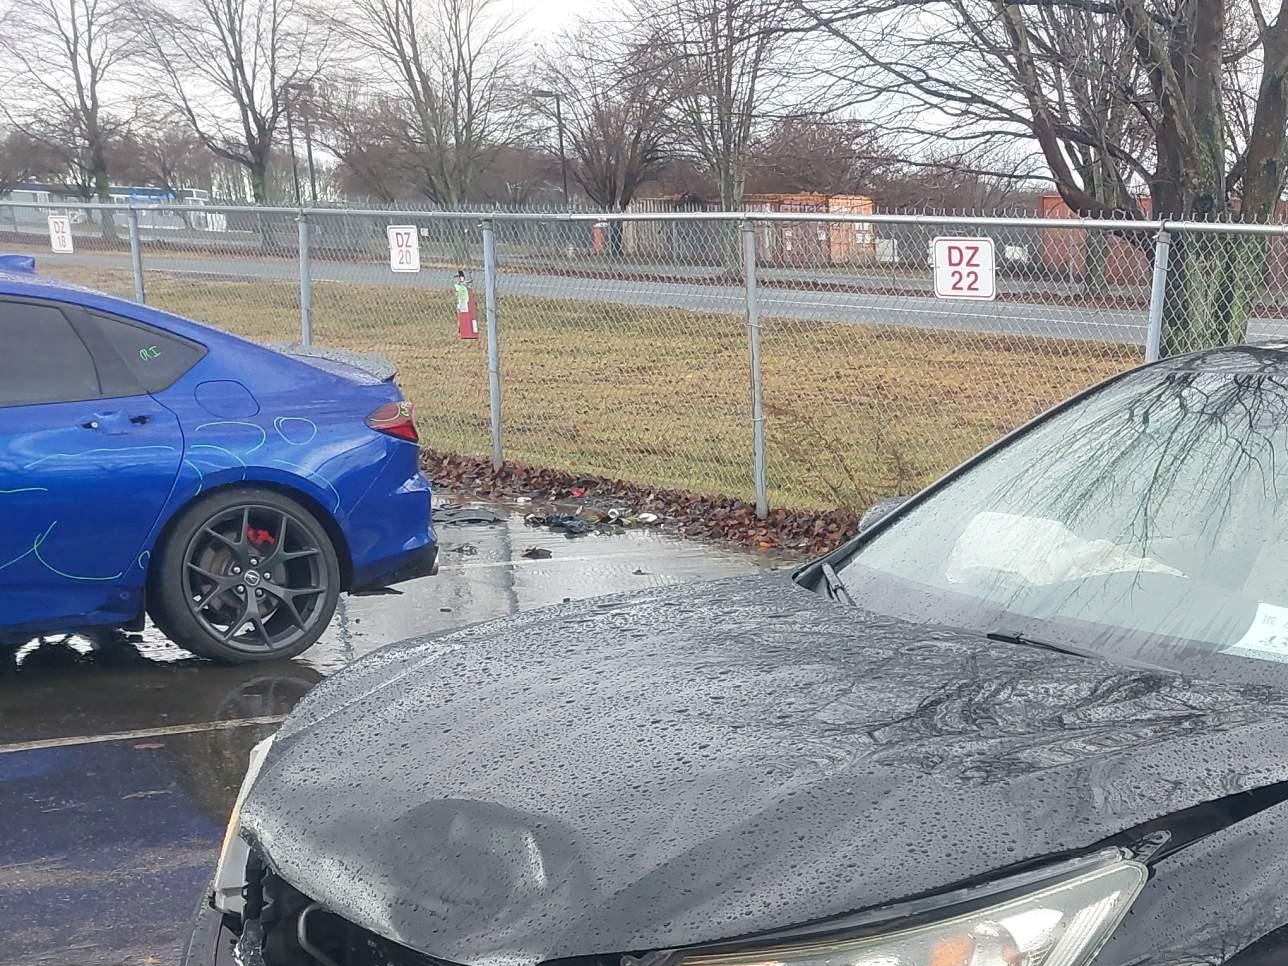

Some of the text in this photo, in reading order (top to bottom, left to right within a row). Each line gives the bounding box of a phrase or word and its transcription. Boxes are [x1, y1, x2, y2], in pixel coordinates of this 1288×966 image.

[53, 221, 66, 234] DZ
[395, 232, 412, 248] DZ
[398, 250, 412, 265] 20
[947, 246, 980, 267] DZ
[951, 270, 979, 291] 22
